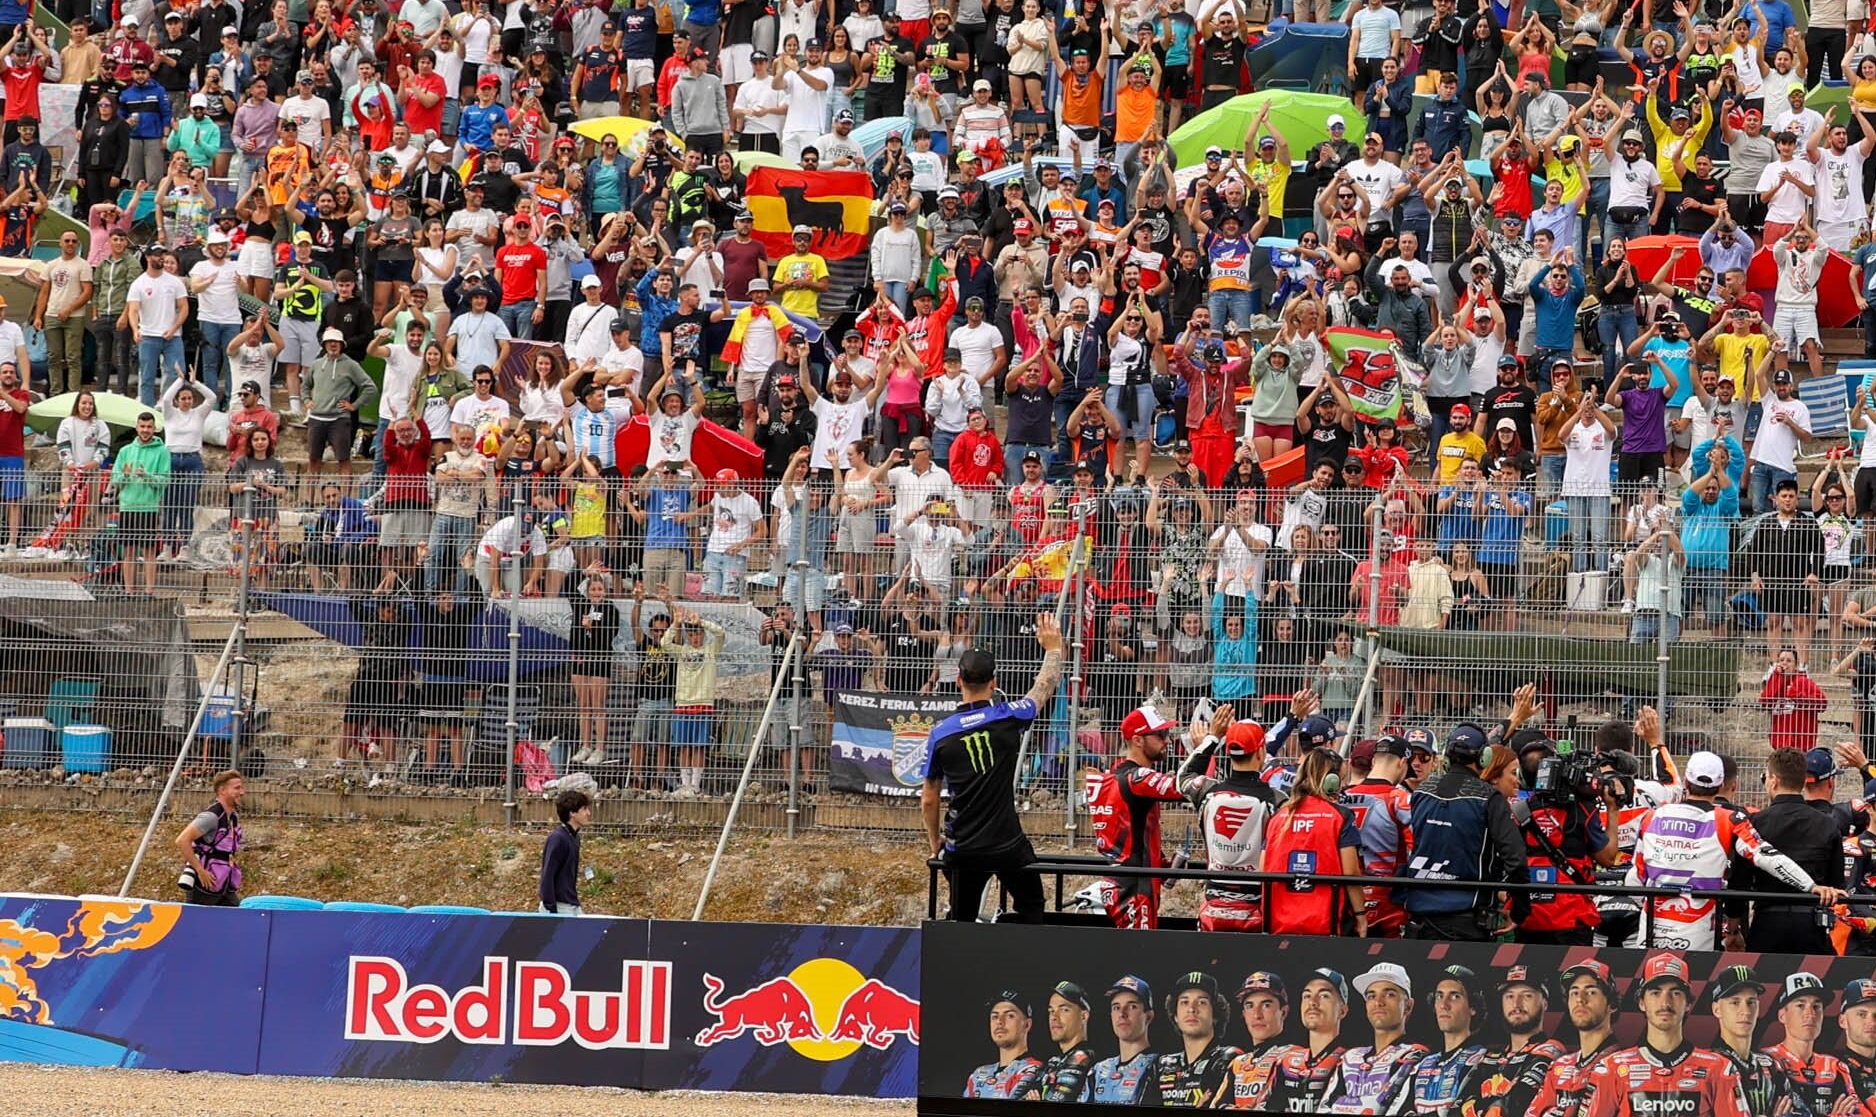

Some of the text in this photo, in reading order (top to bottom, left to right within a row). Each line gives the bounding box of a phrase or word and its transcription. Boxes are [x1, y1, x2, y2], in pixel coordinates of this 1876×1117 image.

[839, 693, 878, 709] XEREZ.
[880, 698, 918, 711] FERIA.
[881, 785, 914, 796] THAT
[1293, 819, 1315, 833] IPF
[345, 956, 673, 1051] Red Bull
[1632, 1098, 1696, 1113] Lenovo
